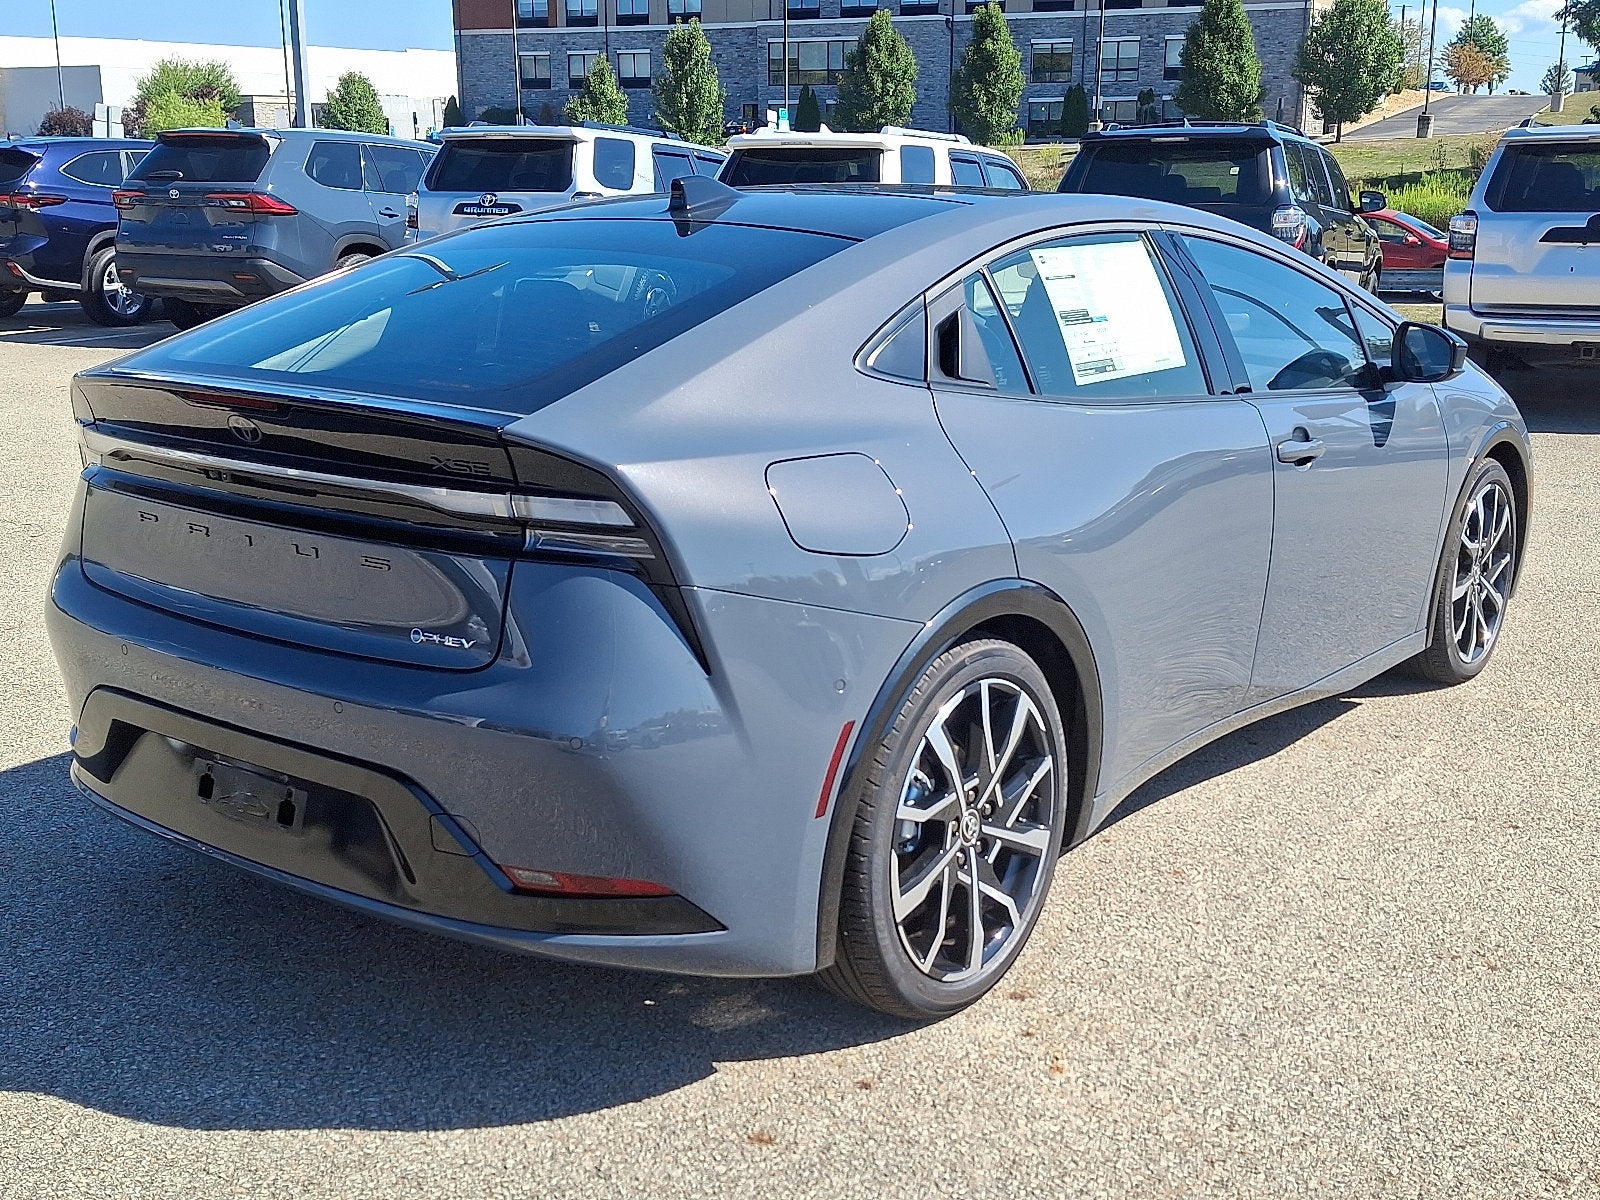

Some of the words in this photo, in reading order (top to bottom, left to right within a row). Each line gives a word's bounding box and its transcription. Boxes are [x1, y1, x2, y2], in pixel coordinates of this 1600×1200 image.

[463, 206, 509, 214] 4RUNNER
[430, 455, 491, 476] XSE
[138, 510, 392, 572] PRIUS
